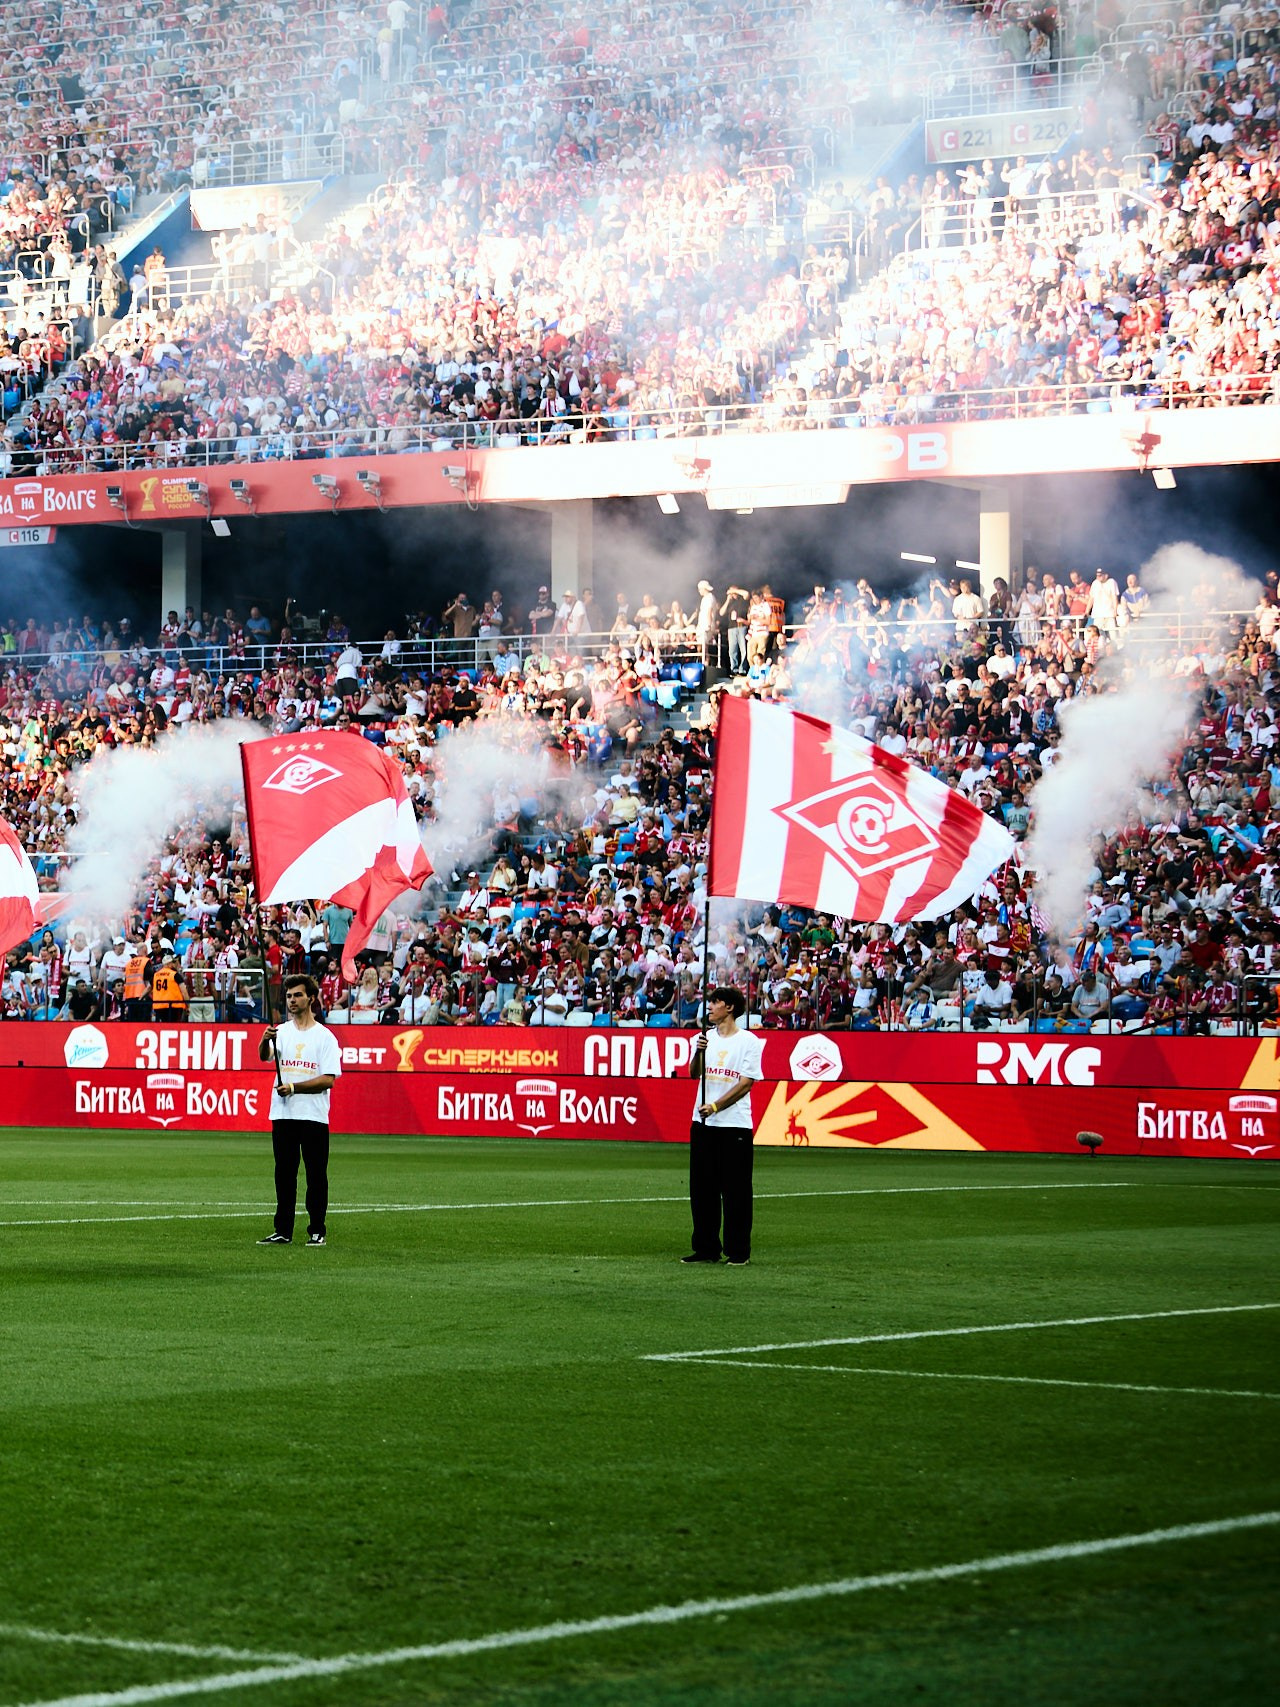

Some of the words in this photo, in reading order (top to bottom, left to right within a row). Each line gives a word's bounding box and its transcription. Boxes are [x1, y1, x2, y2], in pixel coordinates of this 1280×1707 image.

[943, 131, 955, 150] C
[963, 128, 993, 147] 221
[1033, 121, 1069, 140] 220
[21, 529, 40, 542] 116
[155, 978, 168, 991] 64
[135, 1029, 248, 1071] ЗЕНИТ
[423, 1048, 559, 1067] СУПЕРКУБОК
